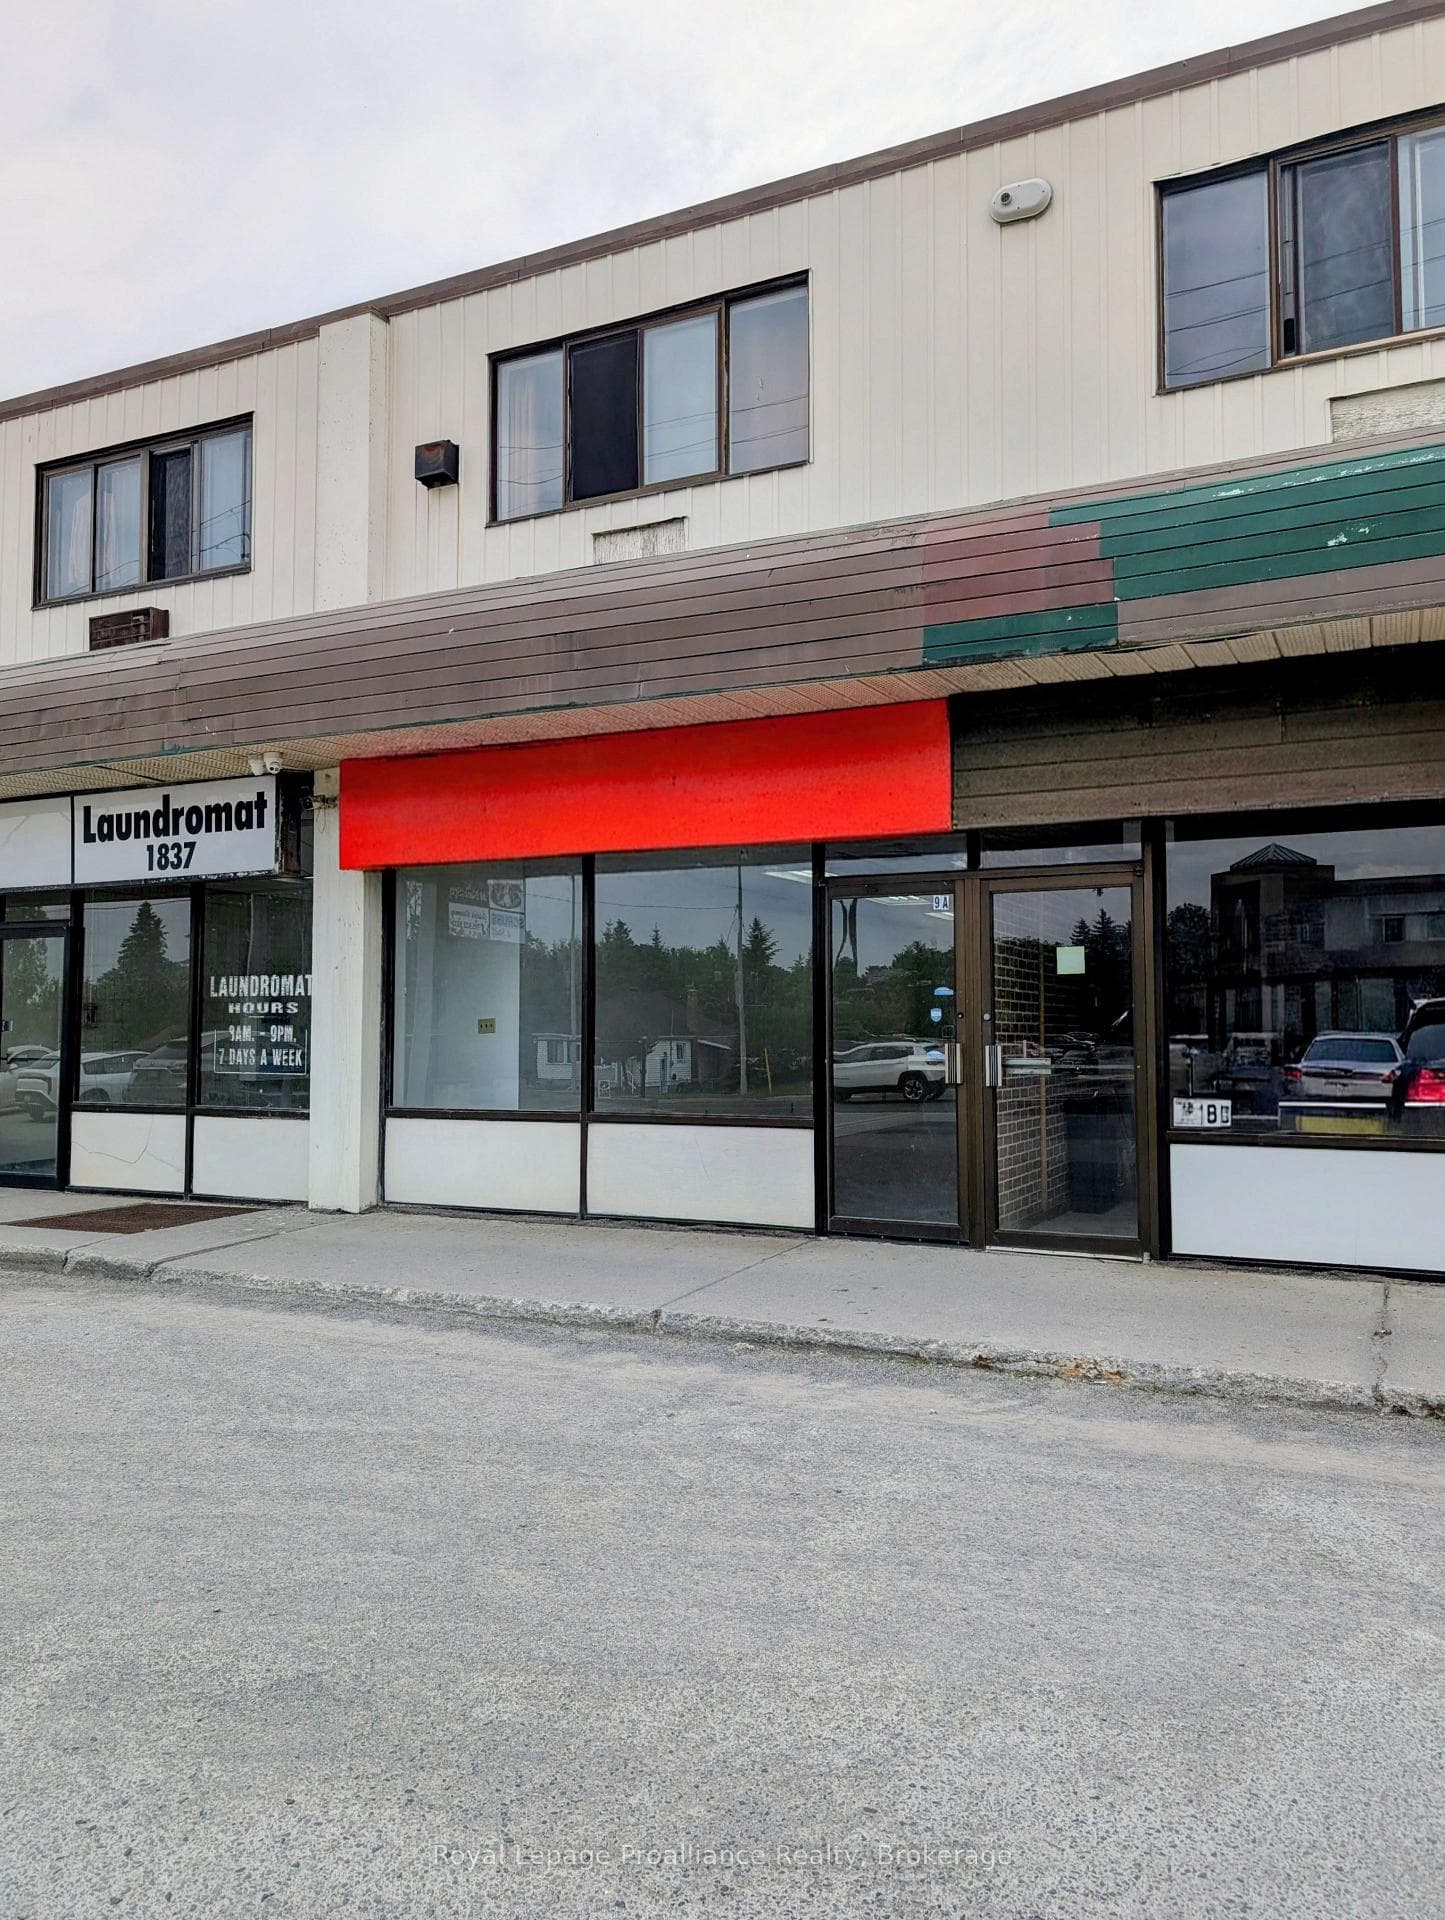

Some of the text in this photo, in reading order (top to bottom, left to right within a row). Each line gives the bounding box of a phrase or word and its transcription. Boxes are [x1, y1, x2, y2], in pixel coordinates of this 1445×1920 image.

[83, 791, 267, 843] Laundromat
[146, 841, 197, 871] 1837
[210, 974, 312, 997] LAUNDROMAT
[228, 1001, 299, 1014] HOURS
[218, 1048, 303, 1067] 7 DAYS A WEEK
